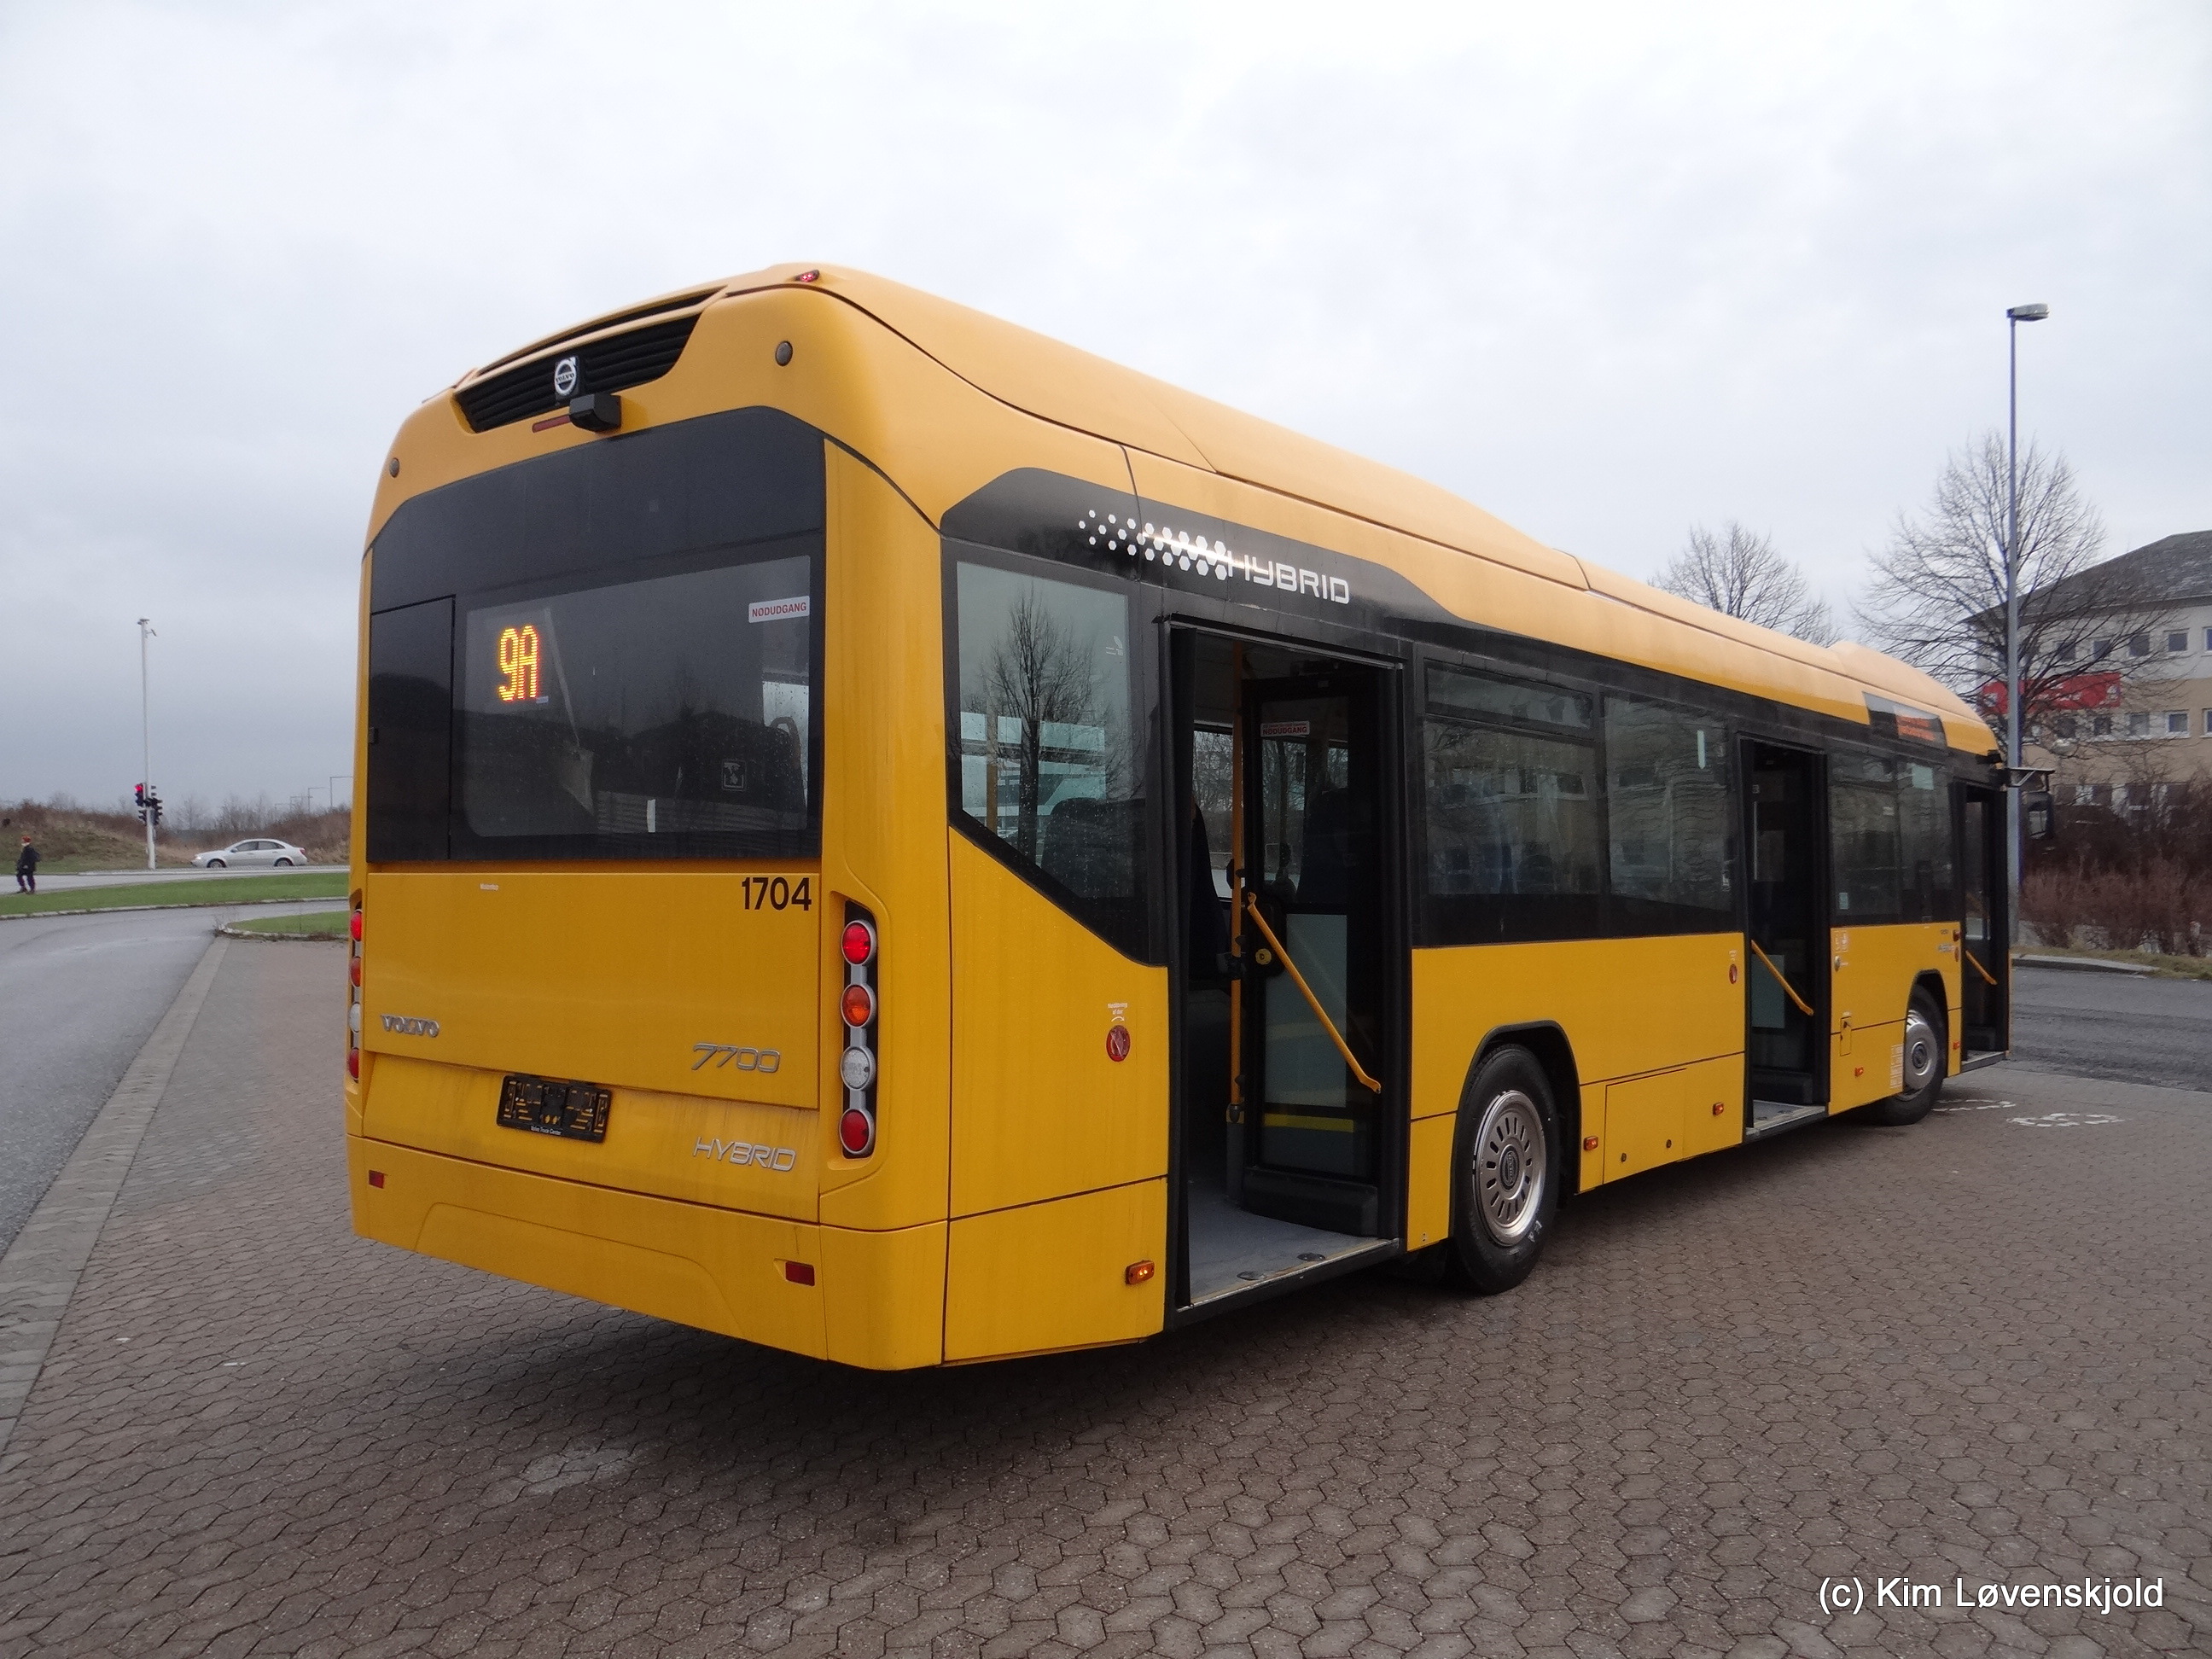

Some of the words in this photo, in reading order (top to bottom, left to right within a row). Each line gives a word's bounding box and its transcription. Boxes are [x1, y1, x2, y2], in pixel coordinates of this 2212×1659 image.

[1227, 550, 1349, 604] HYBRID
[498, 626, 538, 701] 9A
[742, 876, 812, 911] 1704
[380, 1014, 439, 1038] VOLVO
[691, 1043, 780, 1073] 7700
[693, 1137, 796, 1172] HYBRID
